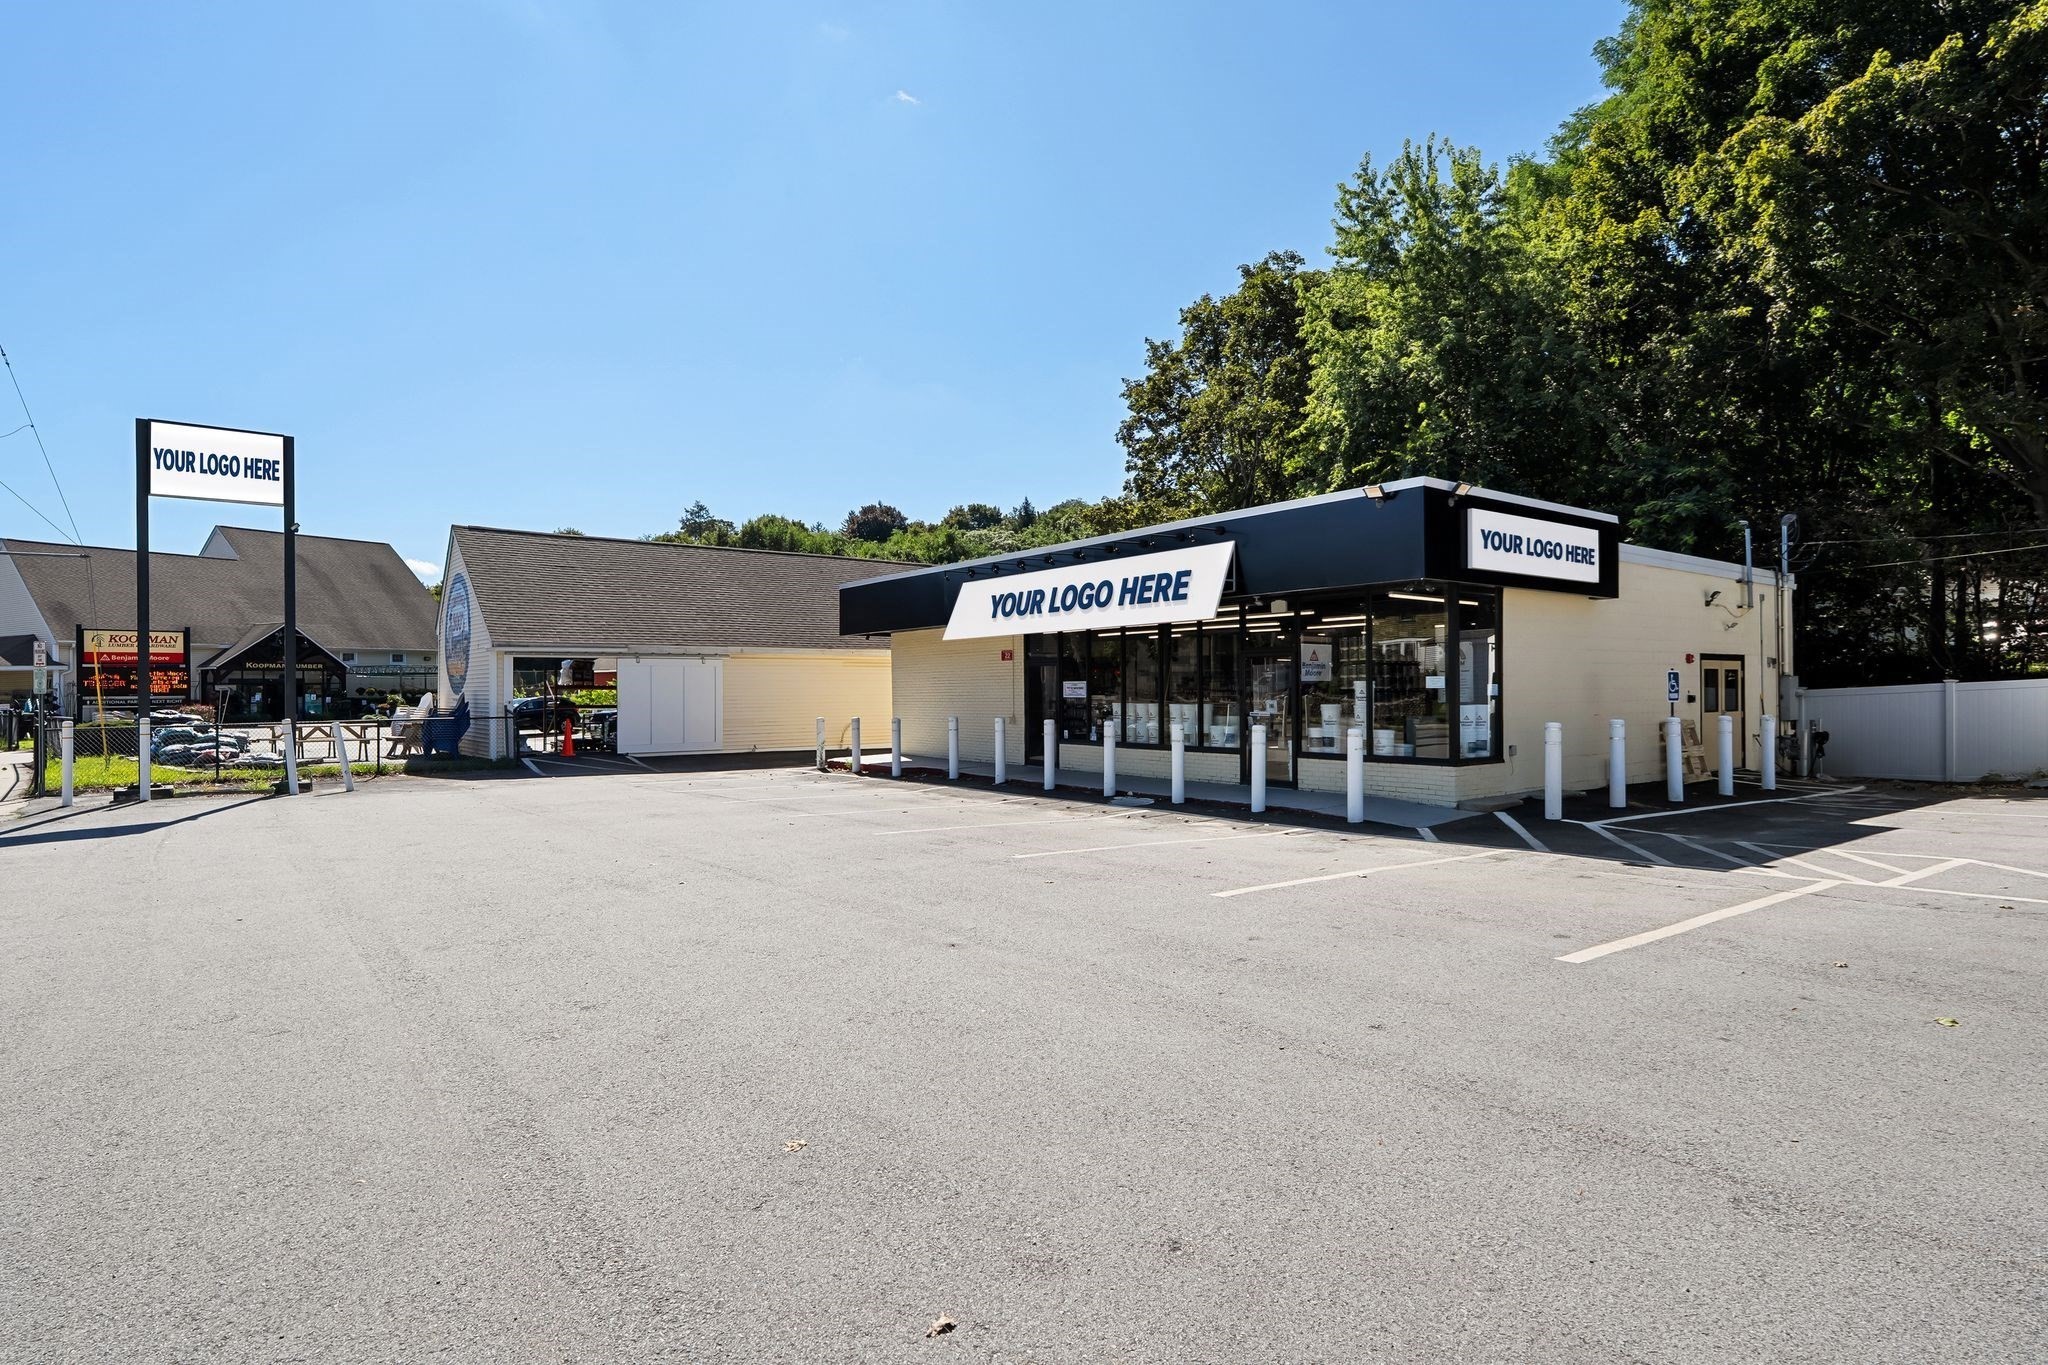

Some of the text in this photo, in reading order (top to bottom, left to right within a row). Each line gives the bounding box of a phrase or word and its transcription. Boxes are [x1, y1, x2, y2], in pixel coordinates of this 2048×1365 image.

[153, 448, 280, 481] YOUR LOGO HERE
[1480, 529, 1595, 566] YOUR LOGO HERE
[991, 570, 1192, 618] YOUR LOGO HERE
[108, 634, 179, 643] KOOMAN
